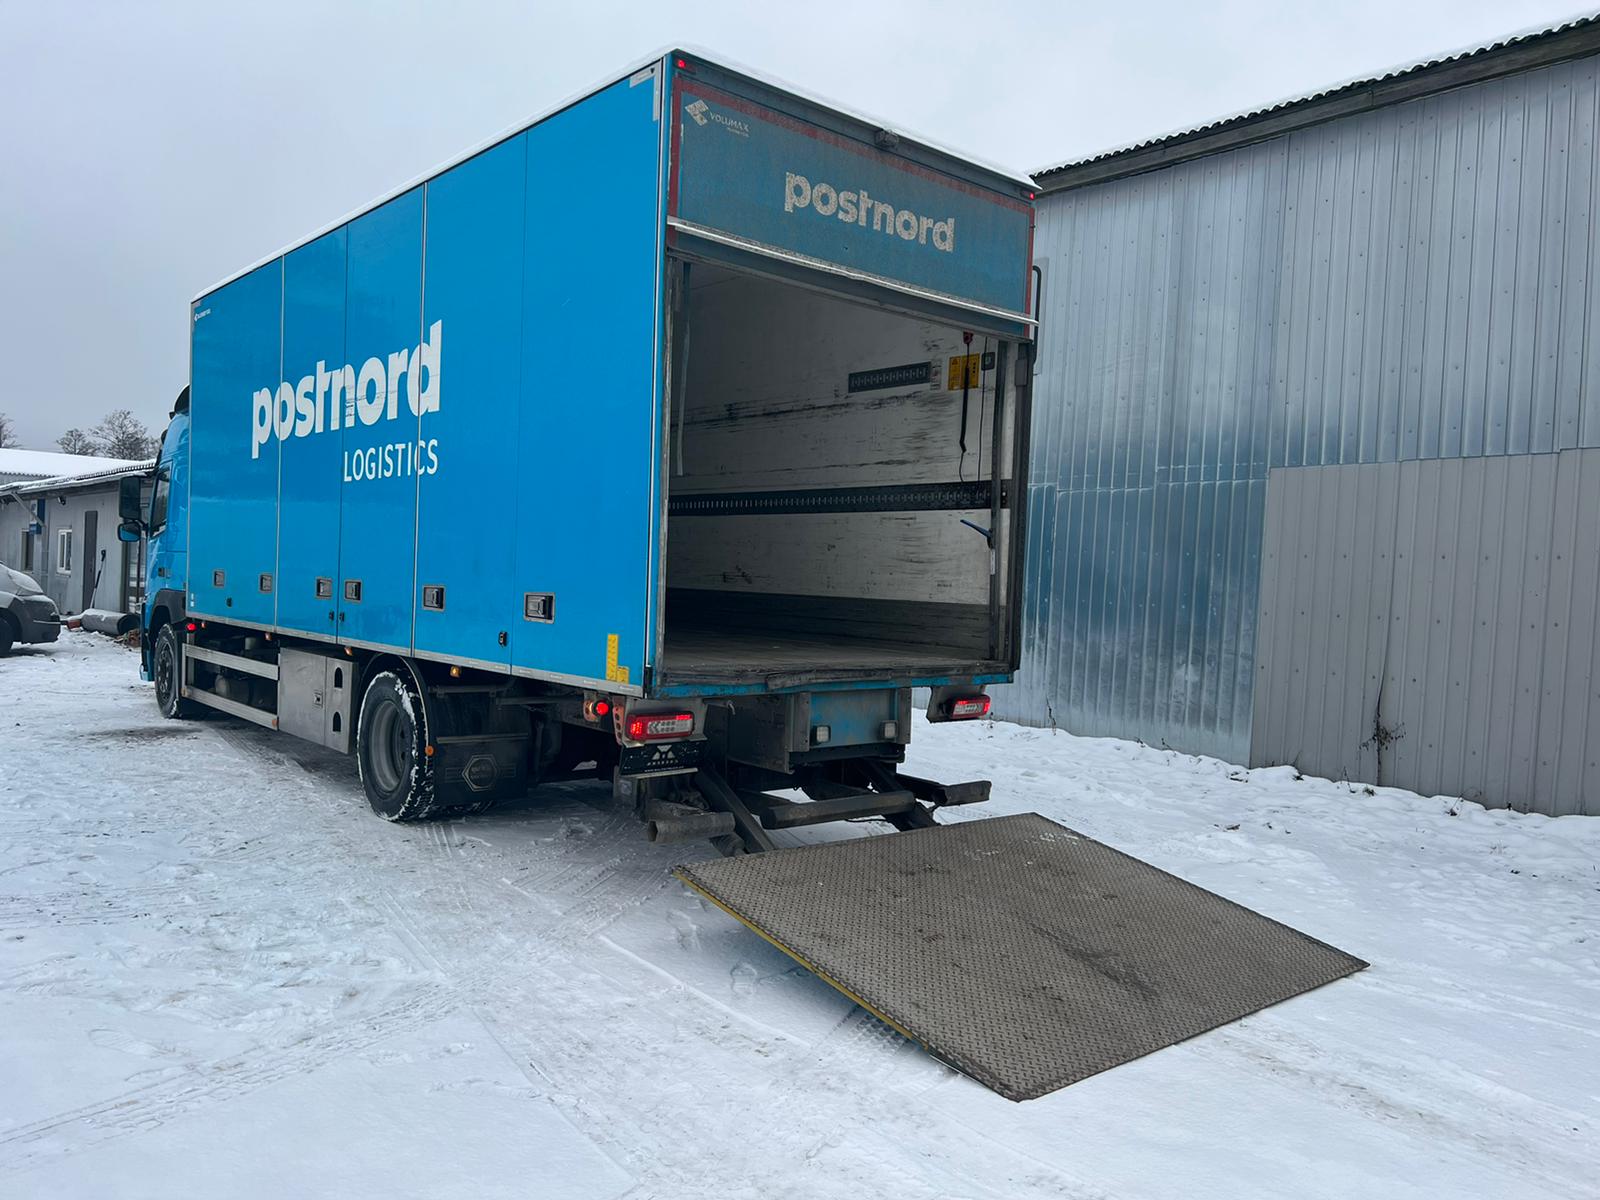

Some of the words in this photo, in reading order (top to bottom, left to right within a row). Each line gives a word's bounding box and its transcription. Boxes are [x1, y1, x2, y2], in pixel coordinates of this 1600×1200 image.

[784, 171, 955, 252] postnord
[251, 319, 442, 460] postnord
[343, 438, 439, 482] LOGISTICS
